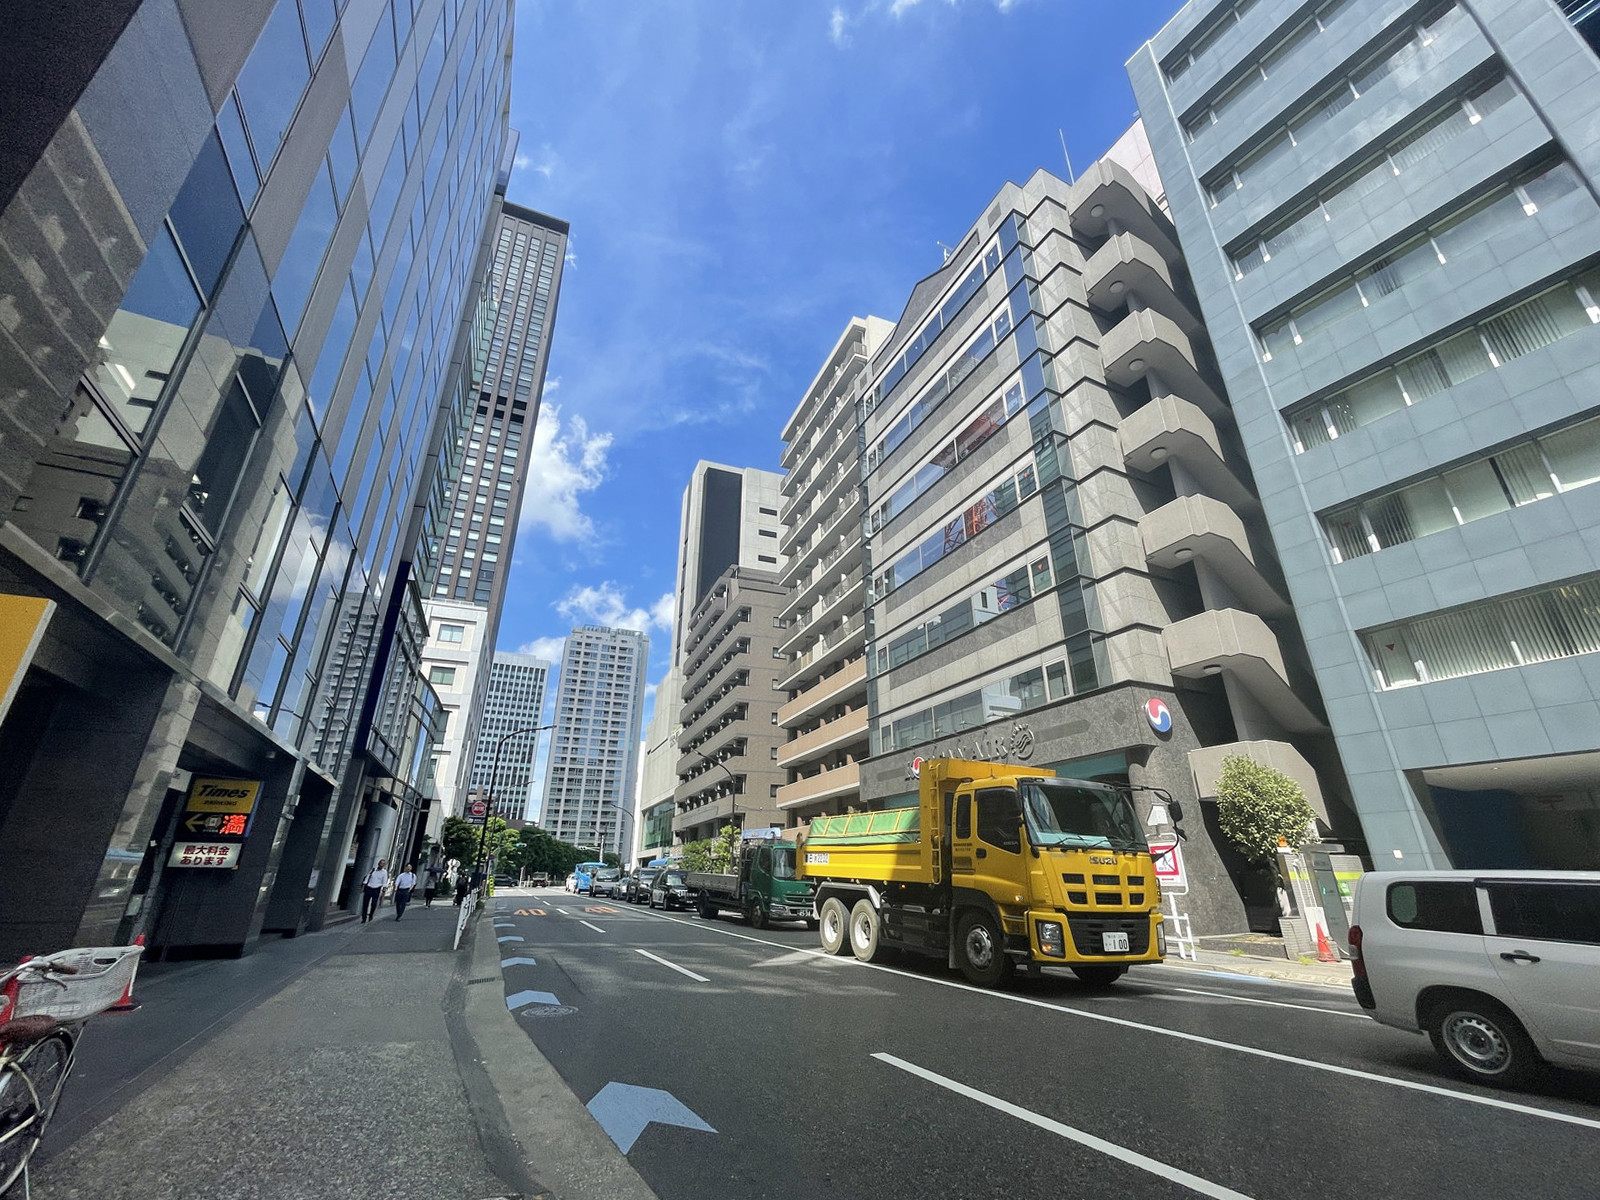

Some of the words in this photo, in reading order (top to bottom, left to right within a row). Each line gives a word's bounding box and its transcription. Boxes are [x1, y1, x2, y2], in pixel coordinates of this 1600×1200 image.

[198, 784, 250, 798] Times
[219, 814, 247, 834] 満
[183, 845, 230, 856] 最大料金
[180, 856, 227, 866] あります
[1089, 856, 1118, 865] ISUZU
[513, 908, 547, 916] 40
